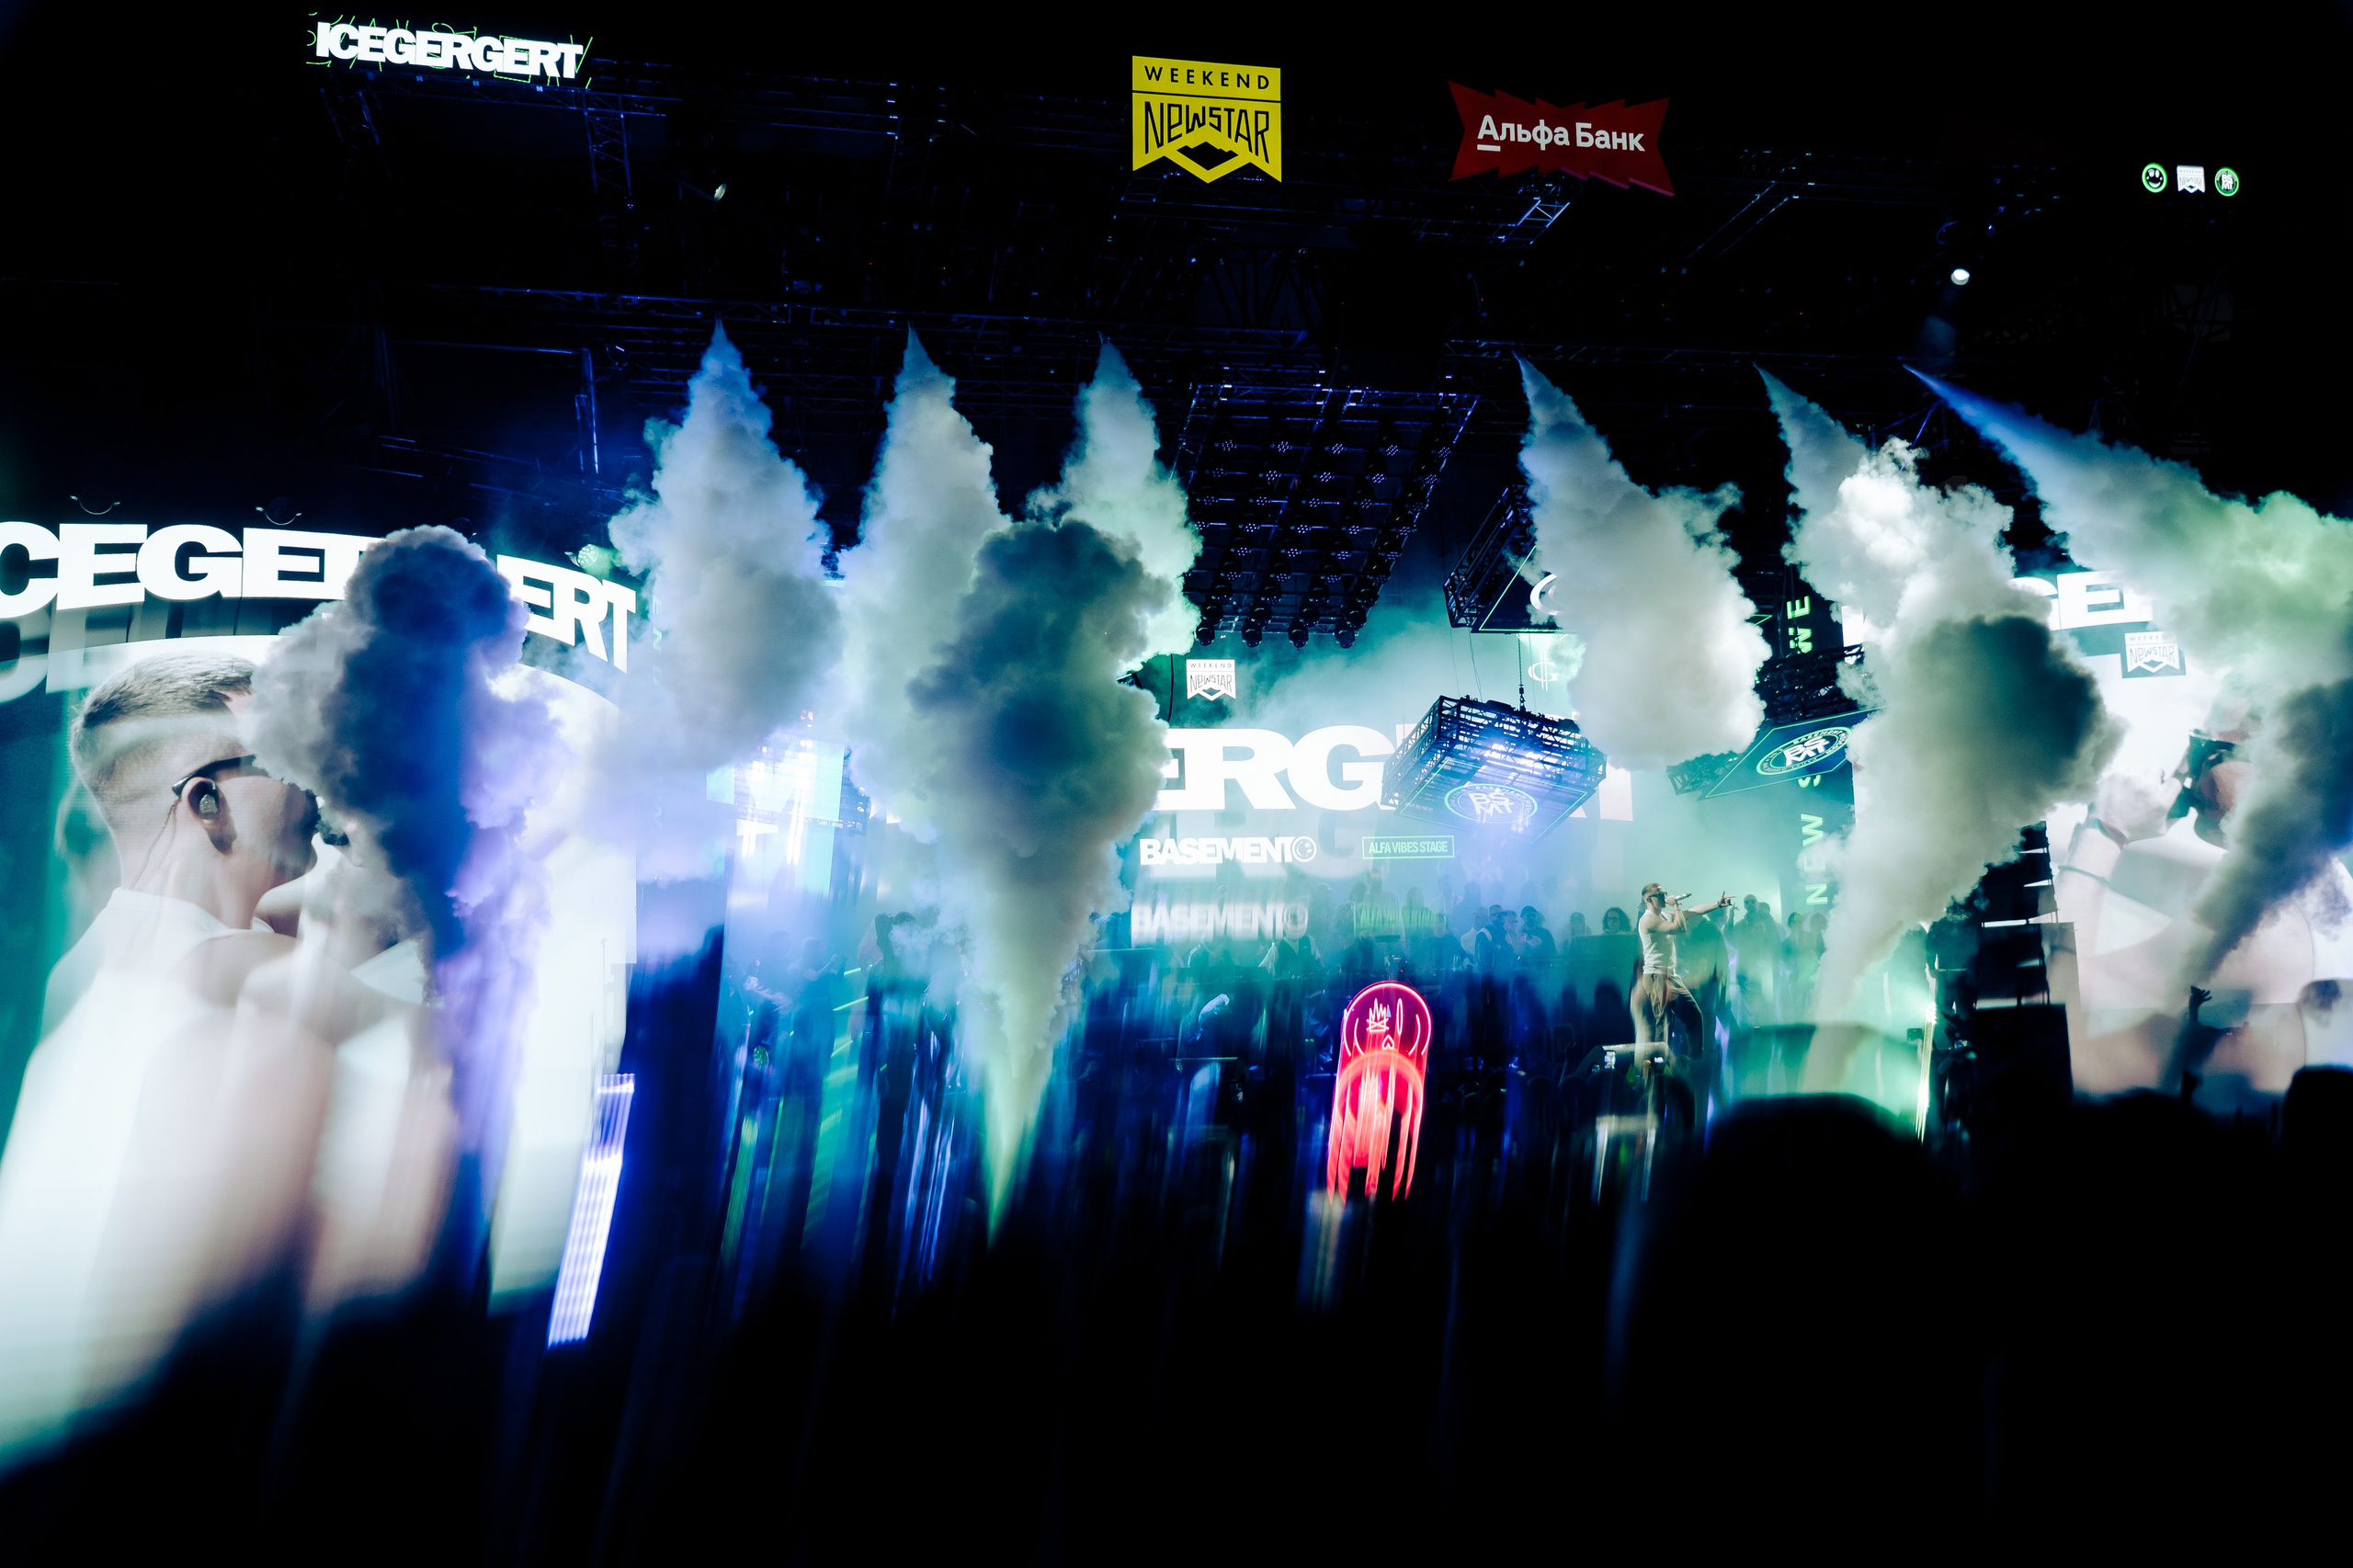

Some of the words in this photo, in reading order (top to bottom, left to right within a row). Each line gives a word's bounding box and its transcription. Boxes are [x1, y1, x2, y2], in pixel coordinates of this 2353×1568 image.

[316, 21, 584, 79] ICEGERGERT
[1144, 65, 1269, 90] WEEKEND
[1477, 115, 1570, 152] Альфа
[1575, 121, 1646, 152] Банк
[1139, 836, 1296, 866] BASEMENT
[1369, 841, 1392, 854] ALFA
[1392, 841, 1419, 854] VIBES
[1419, 840, 1449, 853] STAGE
